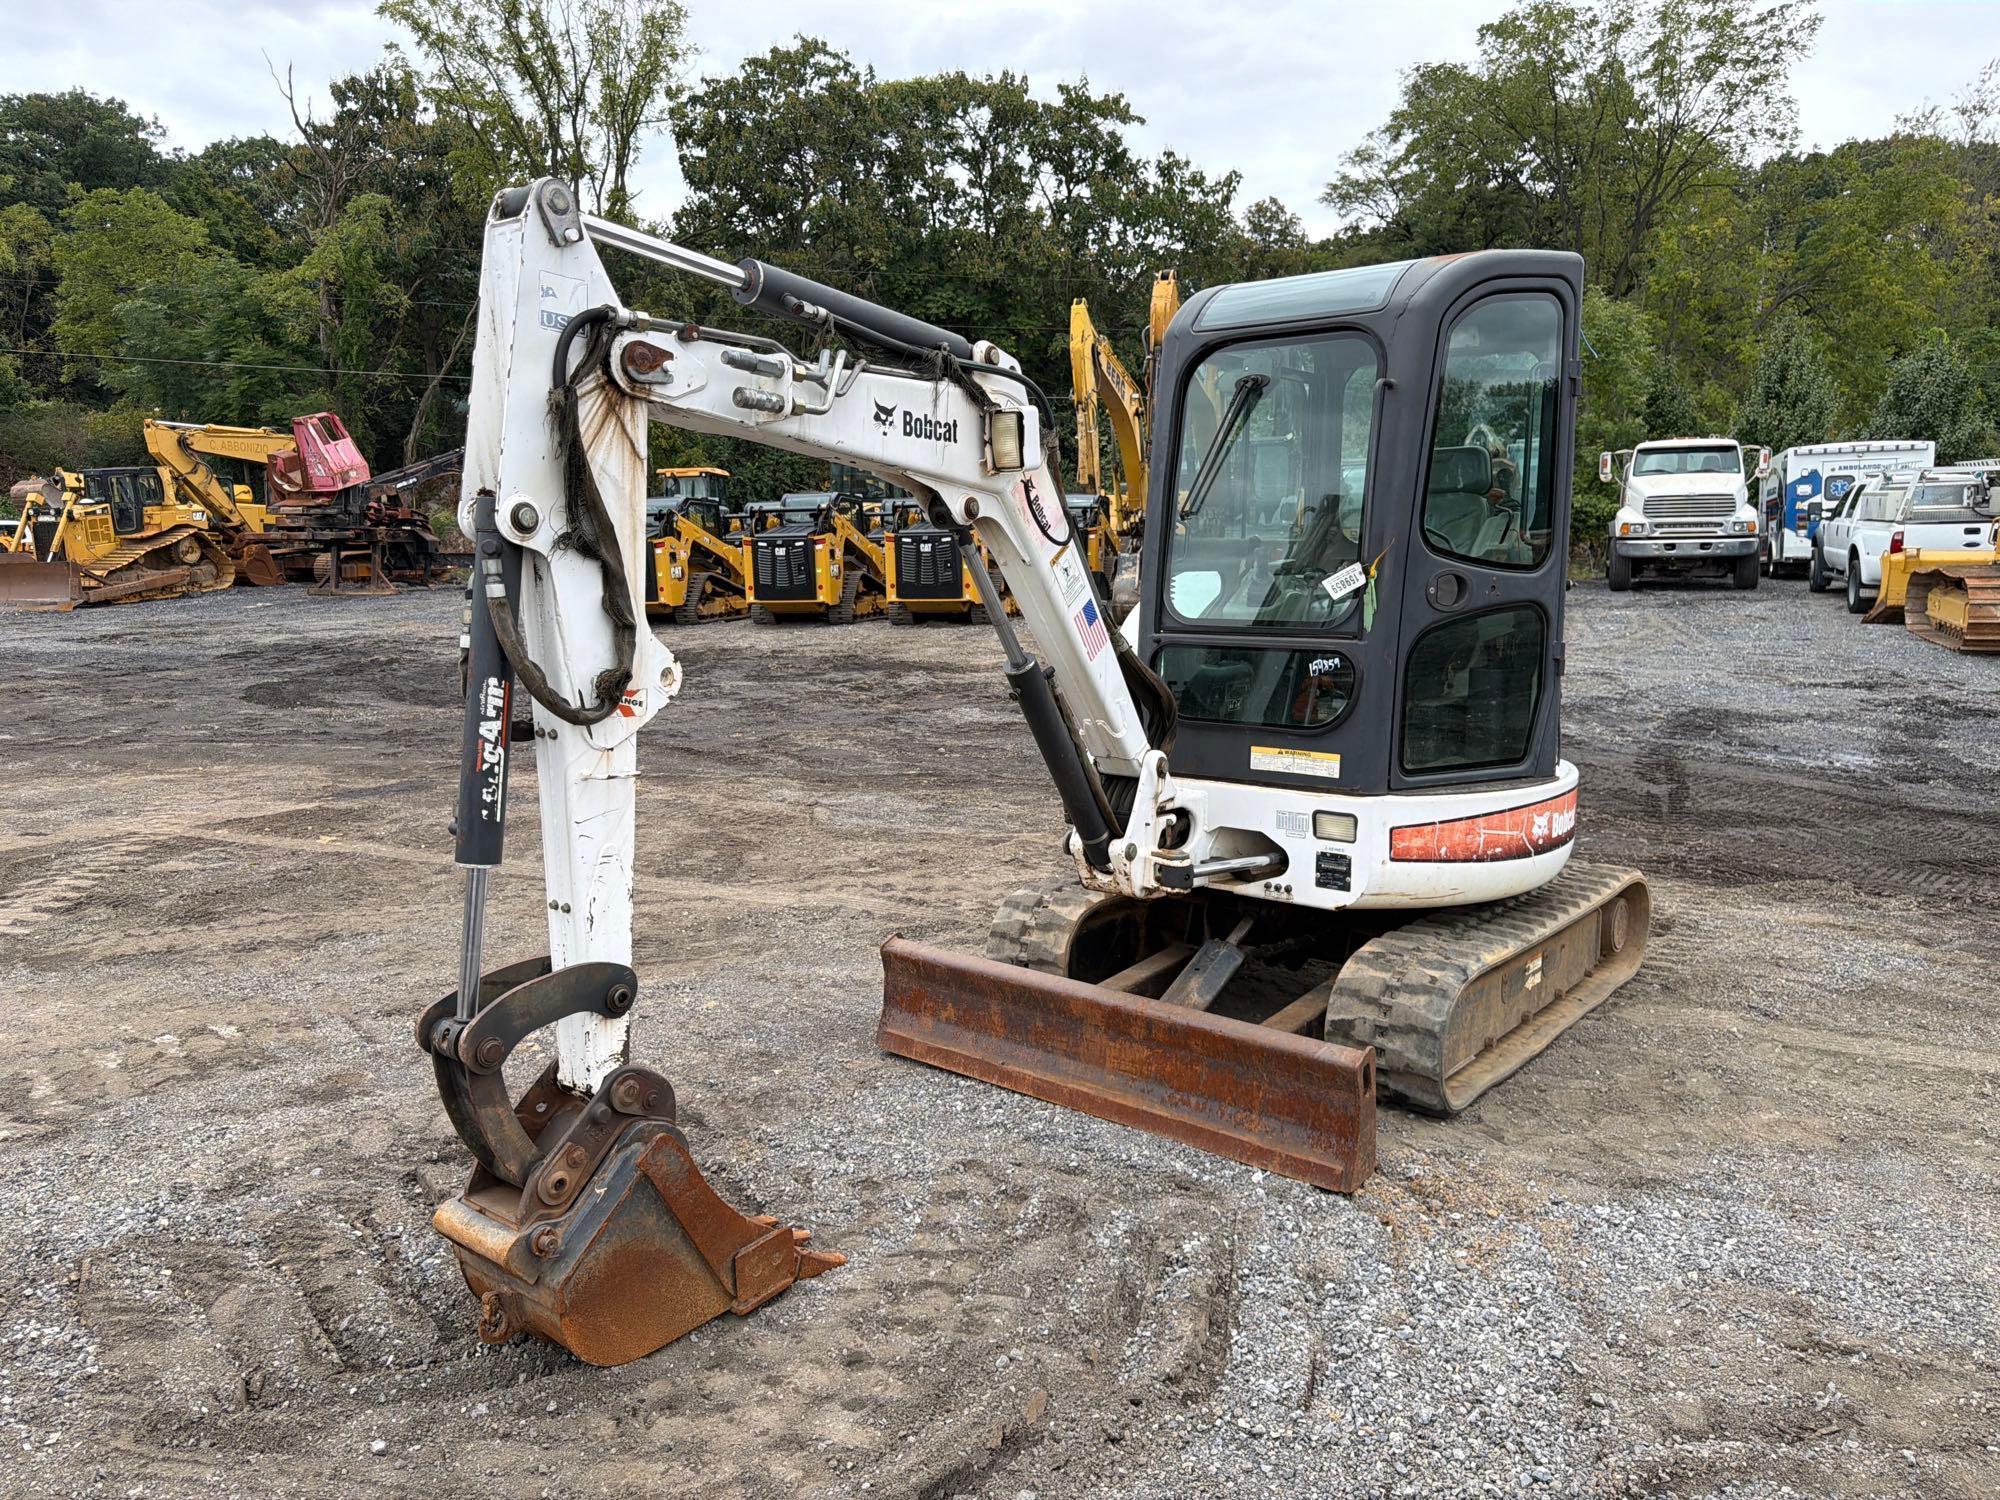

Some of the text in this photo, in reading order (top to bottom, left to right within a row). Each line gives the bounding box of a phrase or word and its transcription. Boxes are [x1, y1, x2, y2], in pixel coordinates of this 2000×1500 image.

[543, 312, 588, 336] US
[903, 410, 958, 444] Bobcat
[775, 547, 786, 556] CAT
[920, 543, 933, 552] CAT
[671, 566, 682, 579] CAT
[830, 564, 840, 577] CAT
[1331, 573, 1360, 594] 159859
[1308, 657, 1341, 678] 159859
